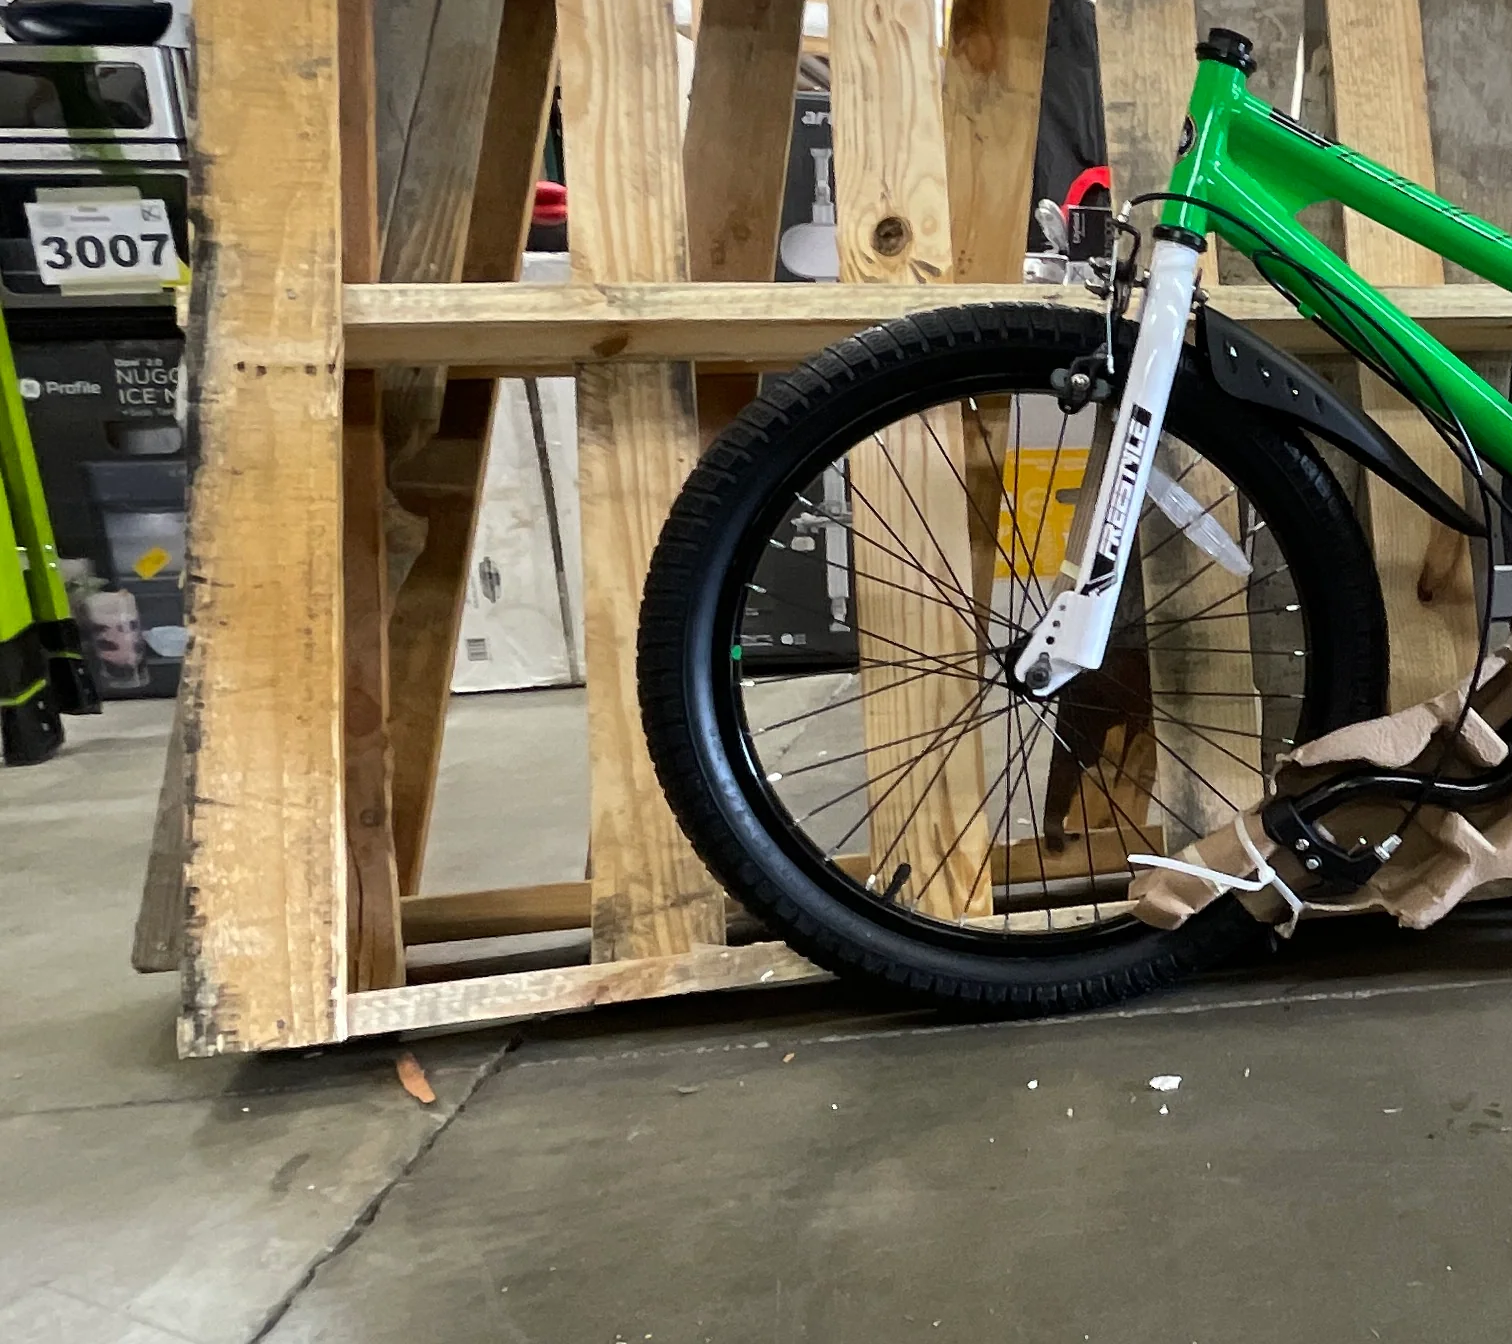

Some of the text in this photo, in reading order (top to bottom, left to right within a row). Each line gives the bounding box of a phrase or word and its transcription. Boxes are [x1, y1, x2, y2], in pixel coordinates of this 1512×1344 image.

[41, 233, 170, 270] 3007
[46, 380, 101, 396] Profile
[119, 388, 157, 404] ICE
[1101, 416, 1150, 561] FREESTYLE
